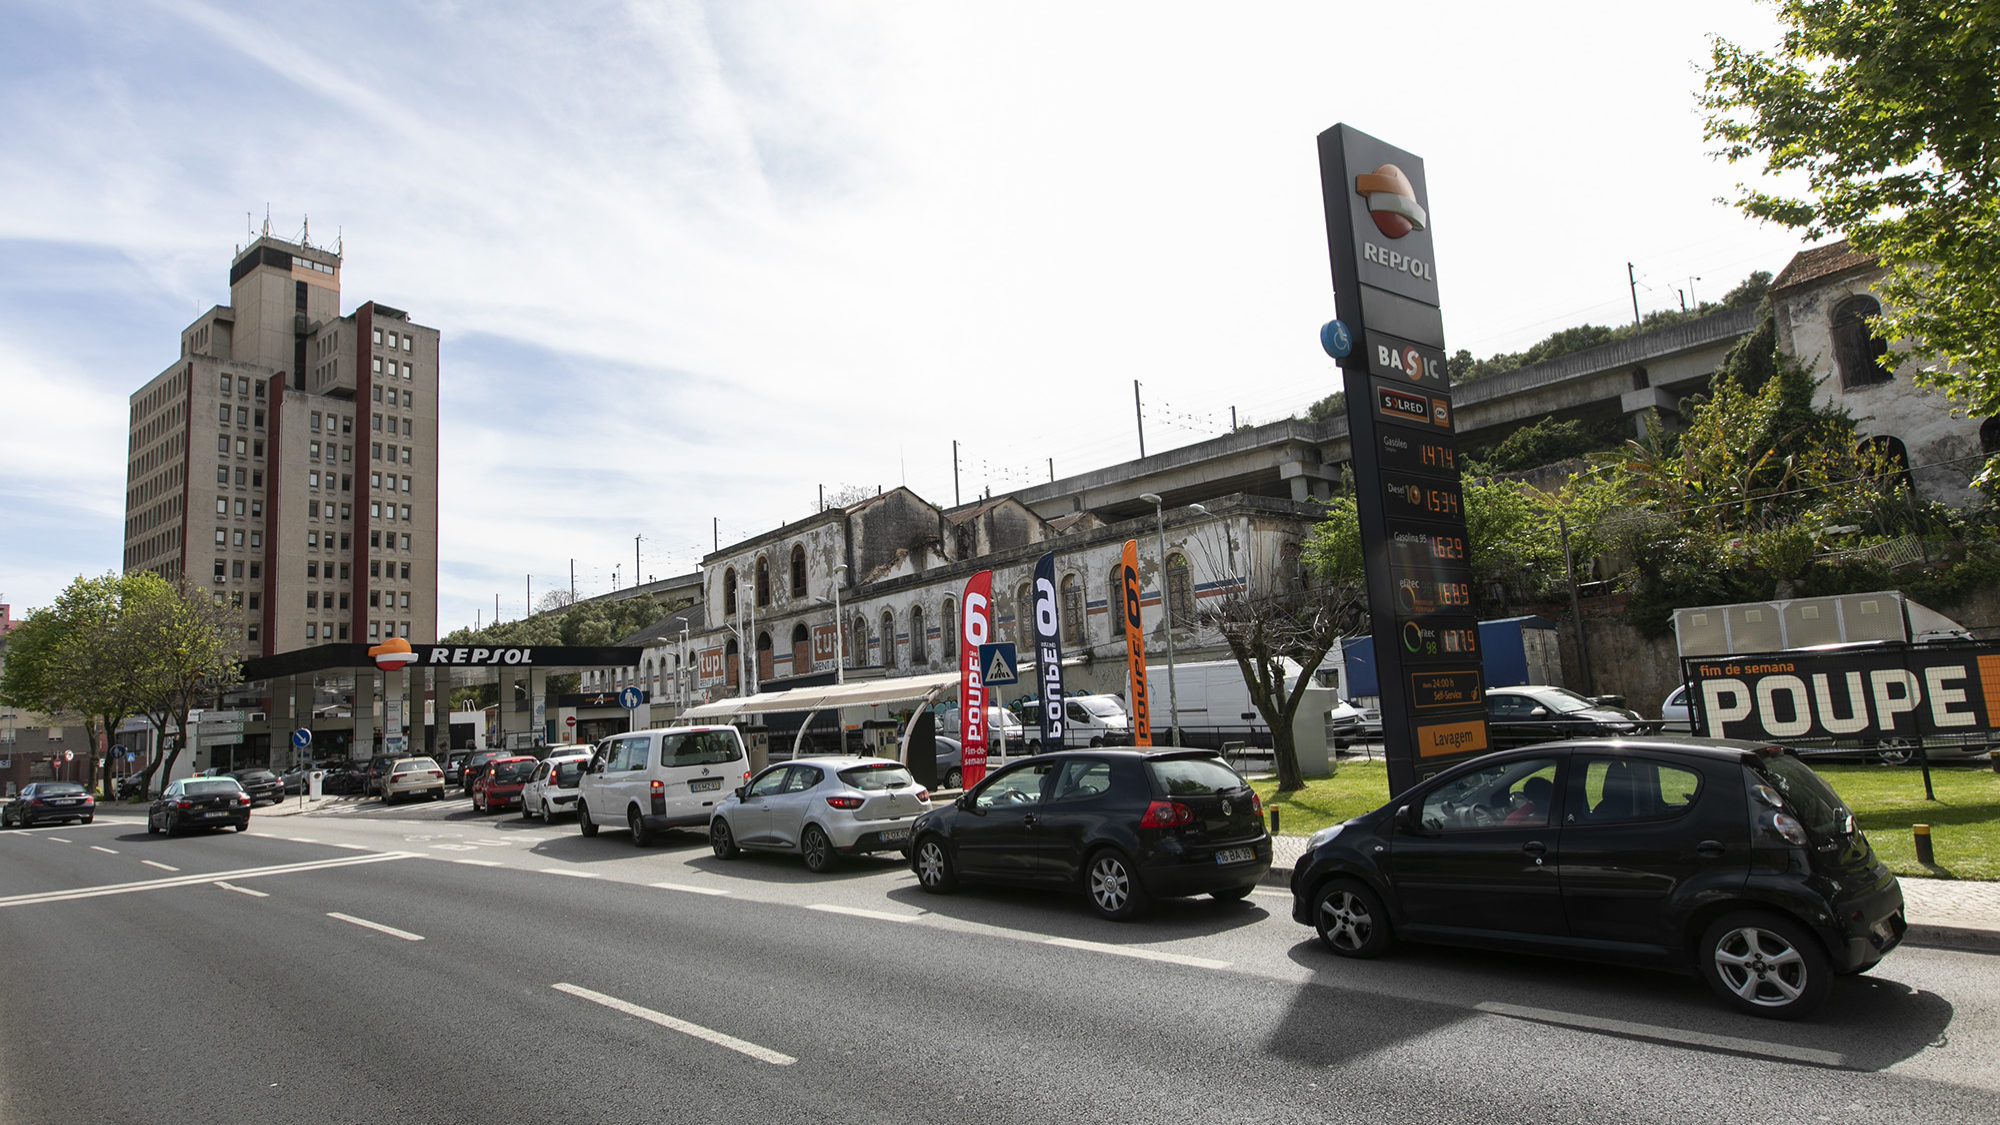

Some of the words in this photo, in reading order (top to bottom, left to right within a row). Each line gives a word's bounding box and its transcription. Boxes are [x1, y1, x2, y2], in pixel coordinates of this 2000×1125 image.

[1364, 242, 1432, 281] REPSOL
[1377, 345, 1439, 379] BASIC
[1385, 397, 1423, 415] SOLRED
[1387, 483, 1405, 494] Diesel
[1394, 531, 1418, 543] Gasolina
[1124, 564, 1141, 630] 6
[965, 592, 988, 647] 6
[429, 647, 533, 664] REPSOL
[1426, 641, 1437, 655] 98
[700, 649, 724, 678] tupi
[815, 661, 830, 671] RENT
[1699, 665, 1723, 676] fim
[1725, 664, 1740, 675] de
[1744, 662, 1795, 674] semana
[968, 655, 982, 741] POUPE
[1133, 641, 1147, 740] POUPE
[1701, 665, 1977, 739] POUPE
[1433, 731, 1473, 749] Lavagem
[964, 755, 986, 766] semana
